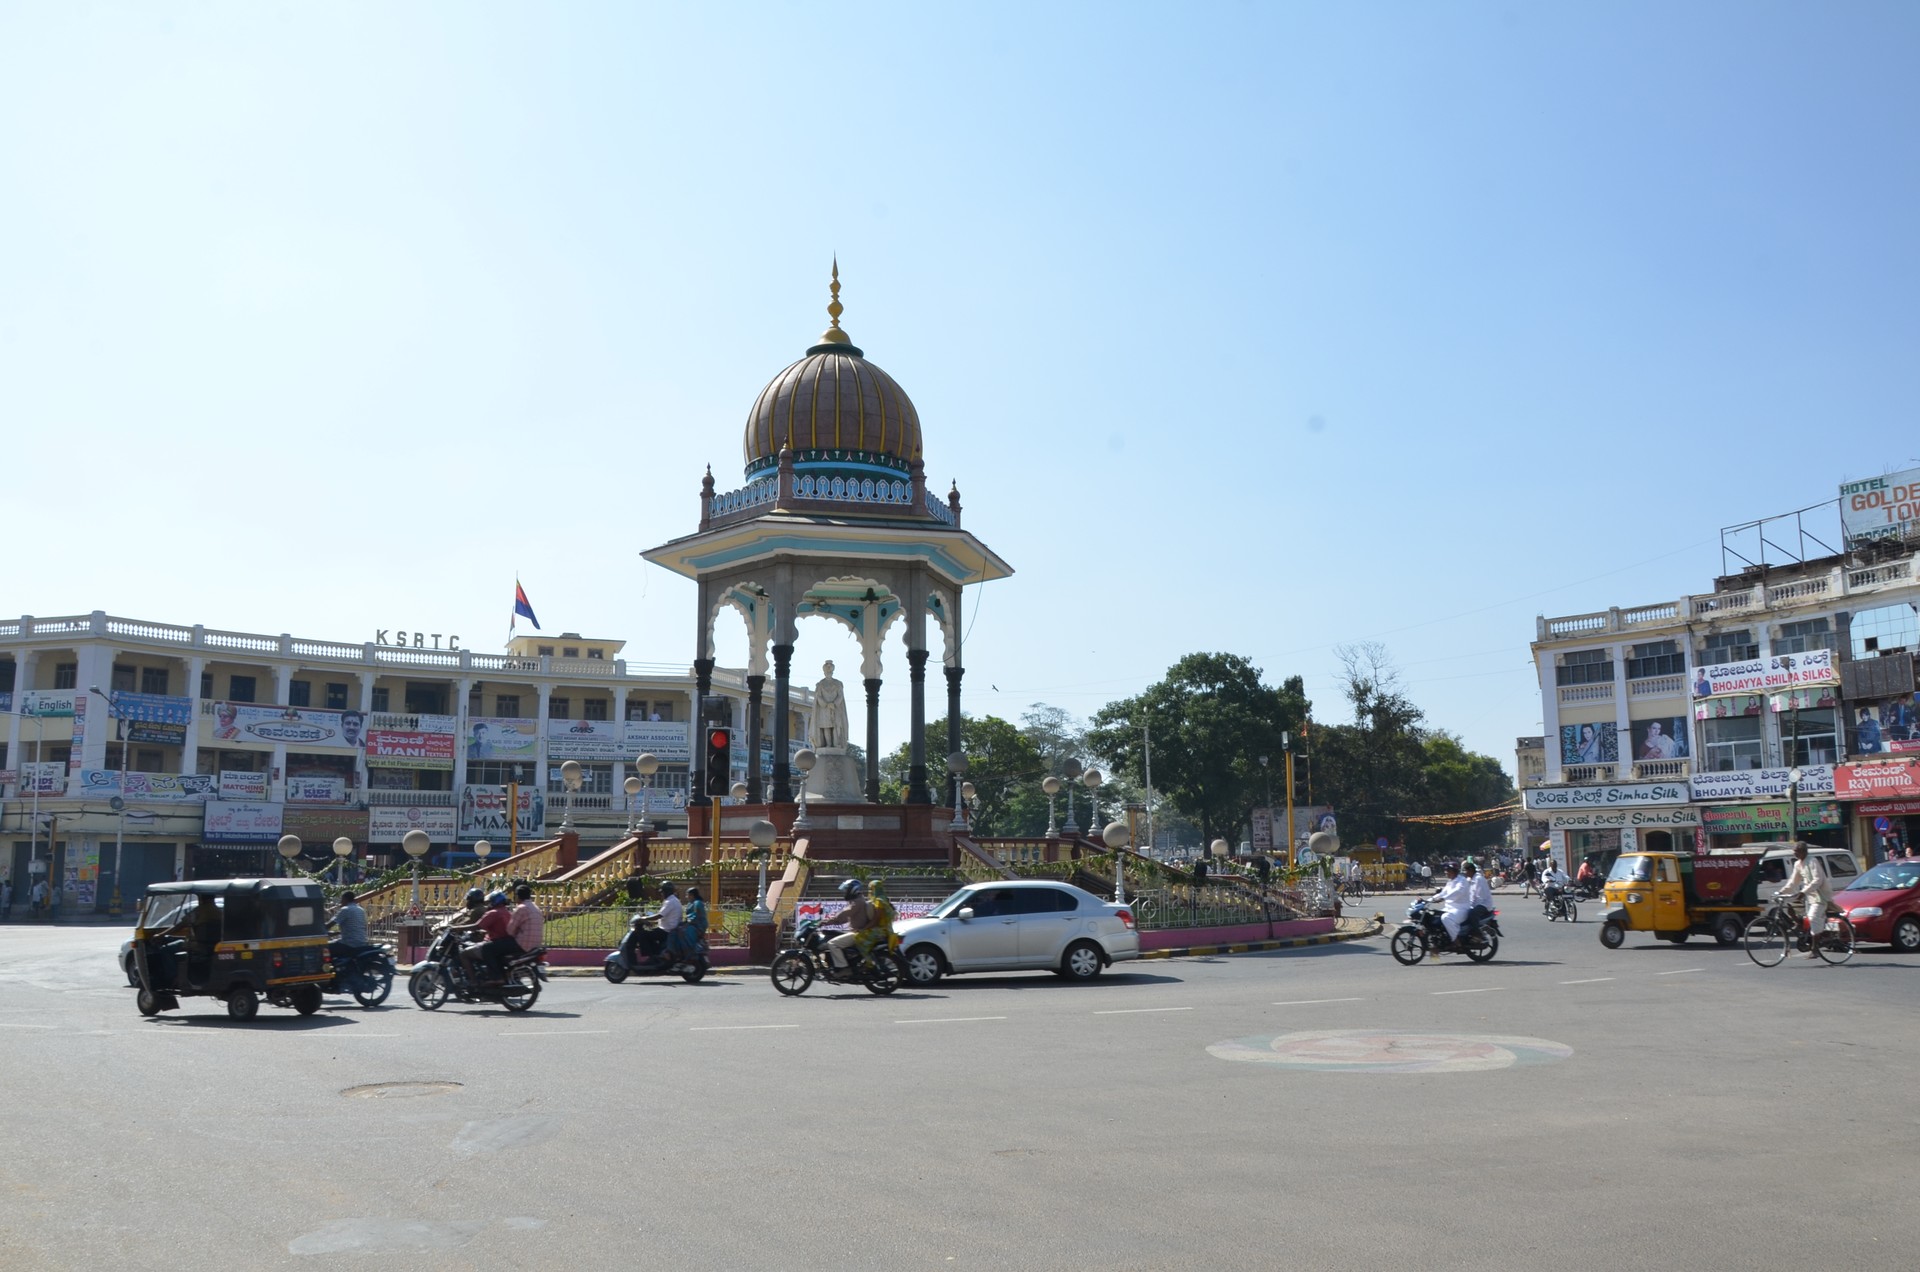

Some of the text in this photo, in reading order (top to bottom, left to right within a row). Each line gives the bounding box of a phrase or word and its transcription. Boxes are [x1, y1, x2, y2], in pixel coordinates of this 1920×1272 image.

[1841, 478, 1889, 496] HOTEL
[1852, 482, 1920, 512] GOLDE
[376, 629, 460, 651] KSRTC
[1712, 667, 1831, 692] BHOJAYYA SHILPA SILKS
[39, 700, 72, 711] English
[569, 726, 595, 734] GMS
[377, 747, 425, 757] MANI
[223, 783, 264, 791] MATCHING
[1535, 791, 1568, 805] ಸಿಂಹ
[1606, 788, 1649, 803] Simha
[1651, 786, 1679, 801] Silk
[1695, 785, 1752, 797] BHOJAYYA
[1755, 783, 1795, 796] SHILP
[1798, 780, 1833, 793] SILKS
[1554, 815, 1590, 827] ಸಿಂಹ
[1631, 812, 1670, 825] Simha
[1671, 810, 1697, 824] Silk
[1706, 819, 1818, 832] BHOJAYYA SHILPA ILKS
